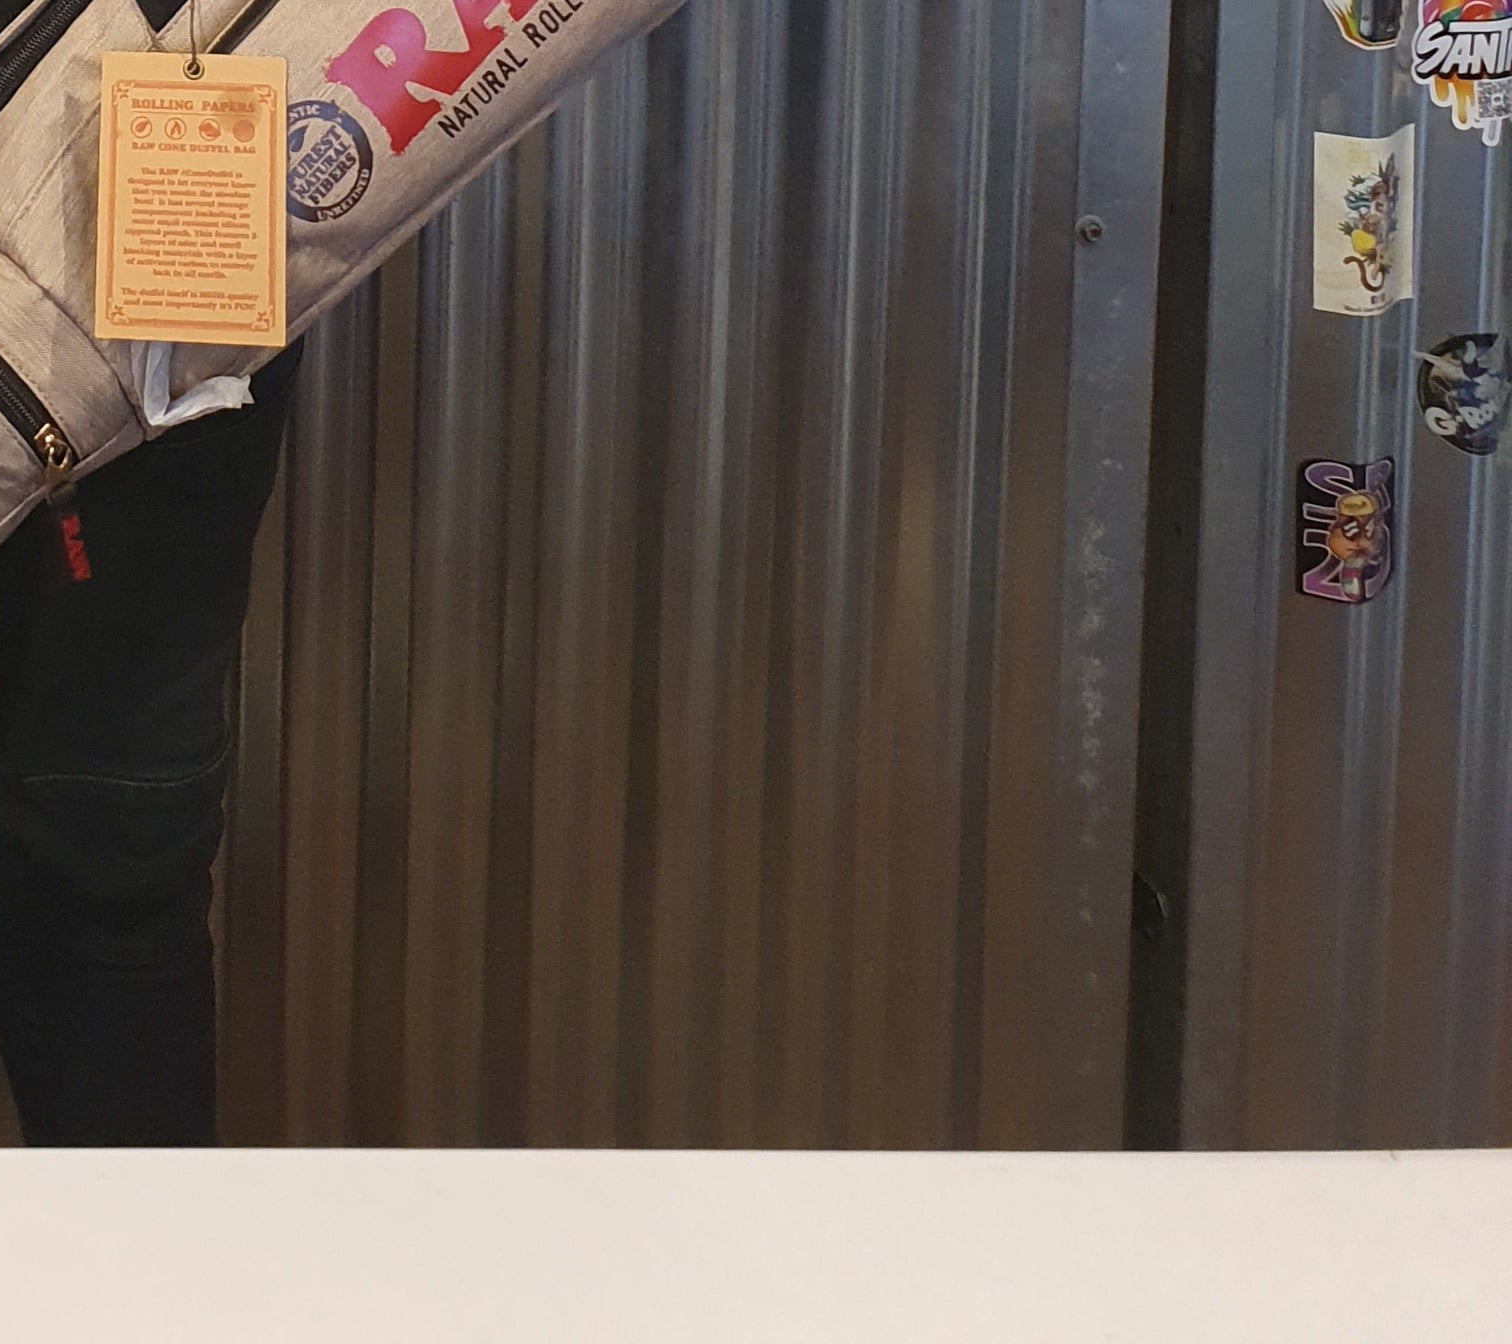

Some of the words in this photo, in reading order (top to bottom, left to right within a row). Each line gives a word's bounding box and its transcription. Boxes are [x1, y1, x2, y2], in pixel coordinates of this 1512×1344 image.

[131, 98, 194, 111] ROLLING
[201, 100, 256, 113] PAPERS
[438, 46, 528, 139] NATURAL
[131, 142, 156, 151] RAW
[158, 143, 187, 152] CONE
[189, 144, 230, 154] DUFFEL
[233, 146, 257, 154] BAG
[294, 141, 352, 200] NATURAL
[308, 152, 357, 205] FIBERS
